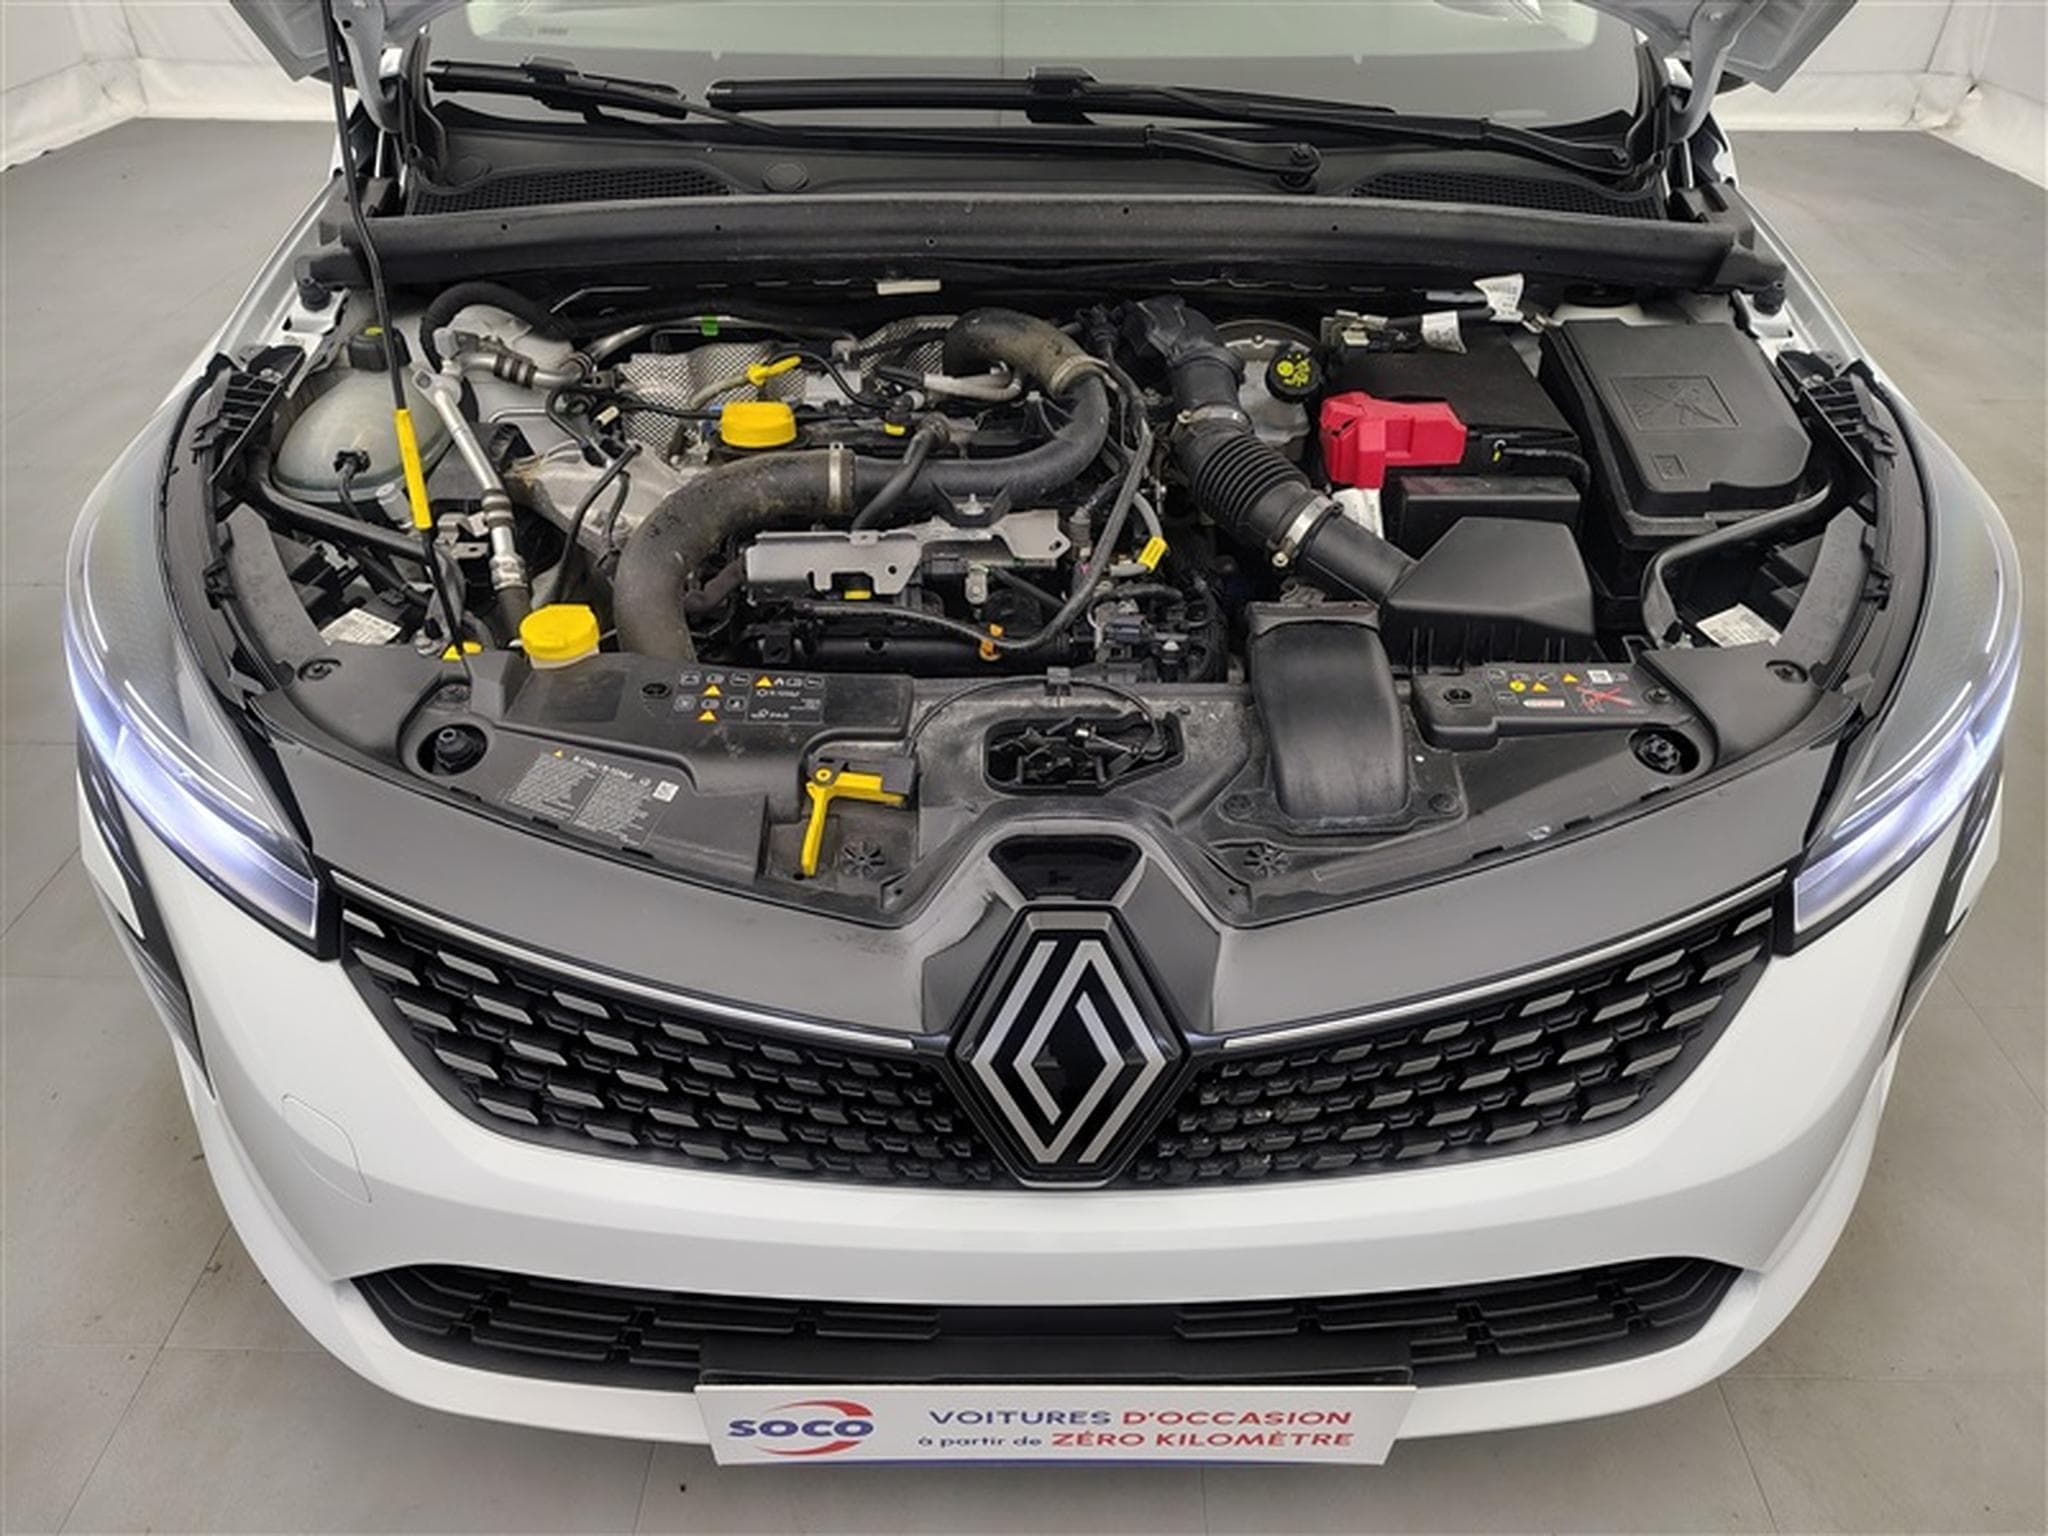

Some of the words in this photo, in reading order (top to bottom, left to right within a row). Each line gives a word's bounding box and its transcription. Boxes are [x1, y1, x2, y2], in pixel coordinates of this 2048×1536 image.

[929, 1410, 1112, 1425] VOITURES
[1122, 1410, 1353, 1426] D'OCCASION
[728, 1420, 874, 1437] SOCO
[917, 1434, 933, 1446] à
[940, 1435, 1006, 1448] partir
[1012, 1435, 1043, 1446] de
[1051, 1430, 1146, 1447] ZÉRO
[1155, 1430, 1355, 1447] KILOMÈTRE
